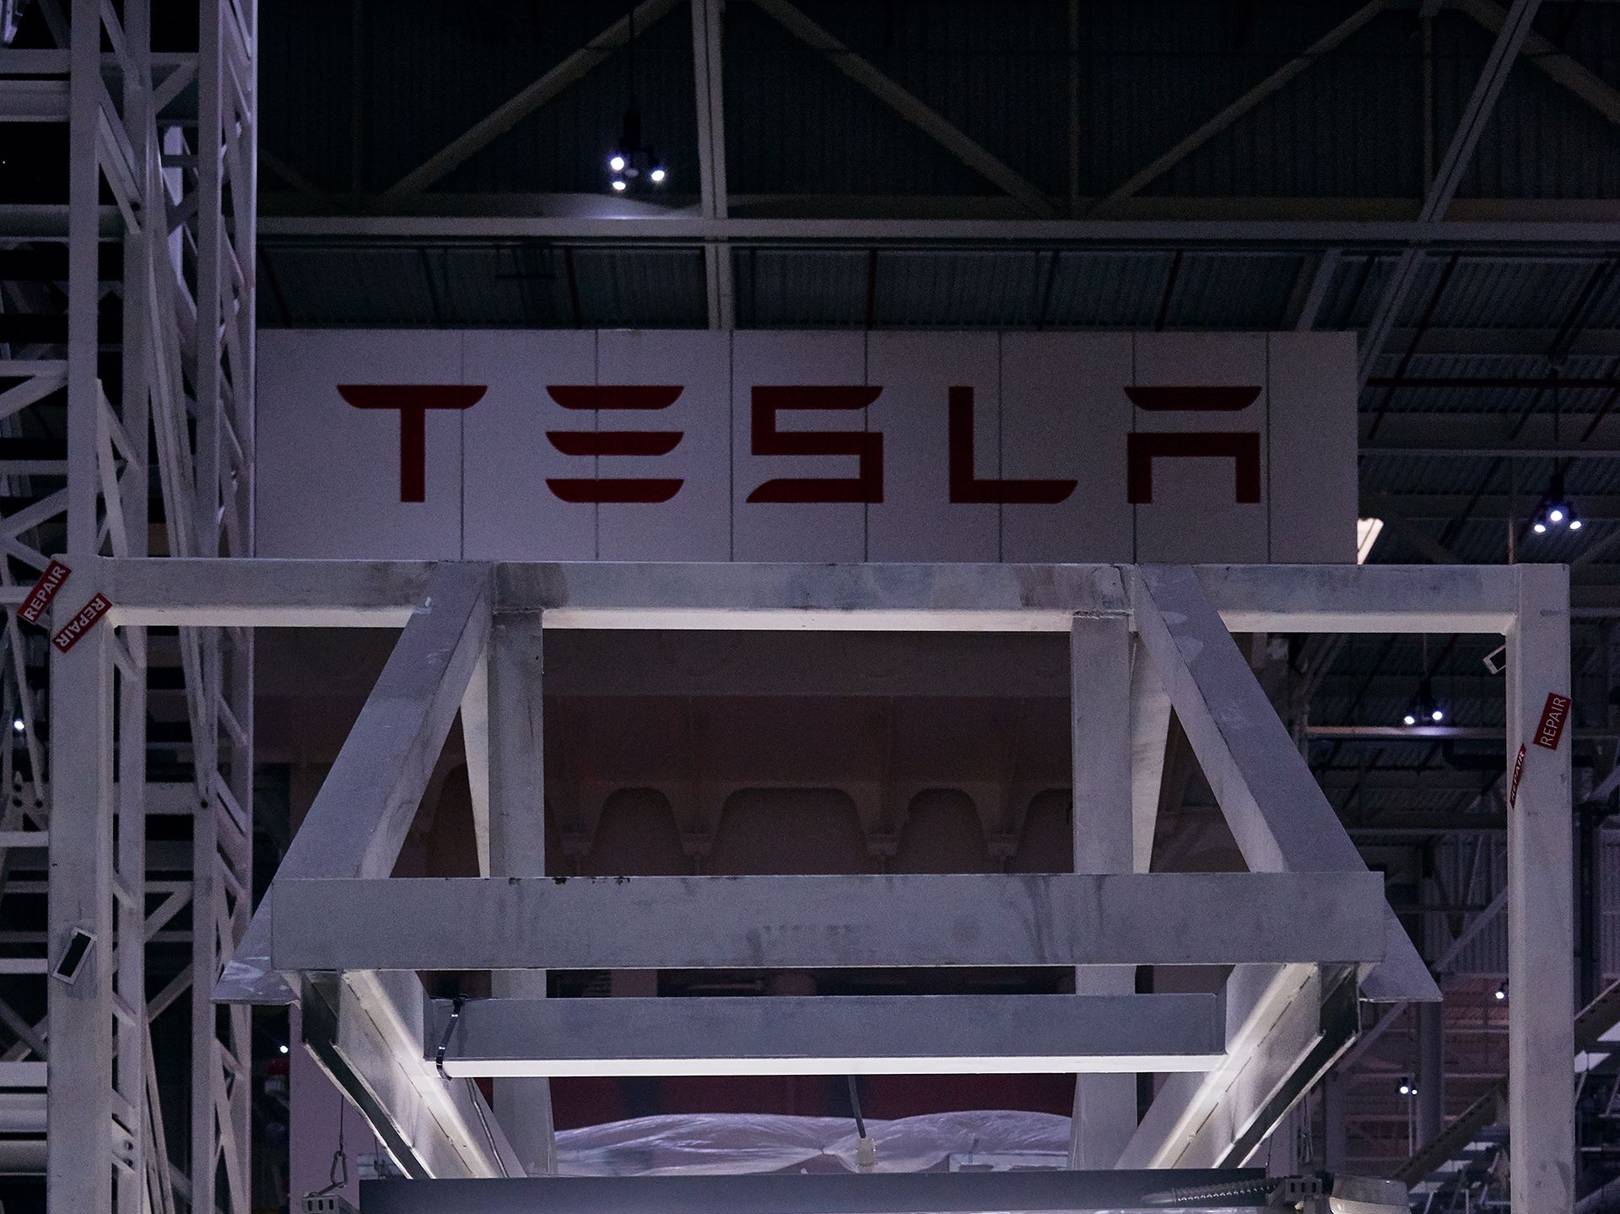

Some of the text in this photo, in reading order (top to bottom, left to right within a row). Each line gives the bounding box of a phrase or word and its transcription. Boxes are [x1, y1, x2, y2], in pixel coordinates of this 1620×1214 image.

[337, 384, 1263, 504] TESLA
[24, 566, 66, 620] REPAIR
[56, 597, 105, 647] REPAIR
[1540, 697, 1566, 746] REPAIR
